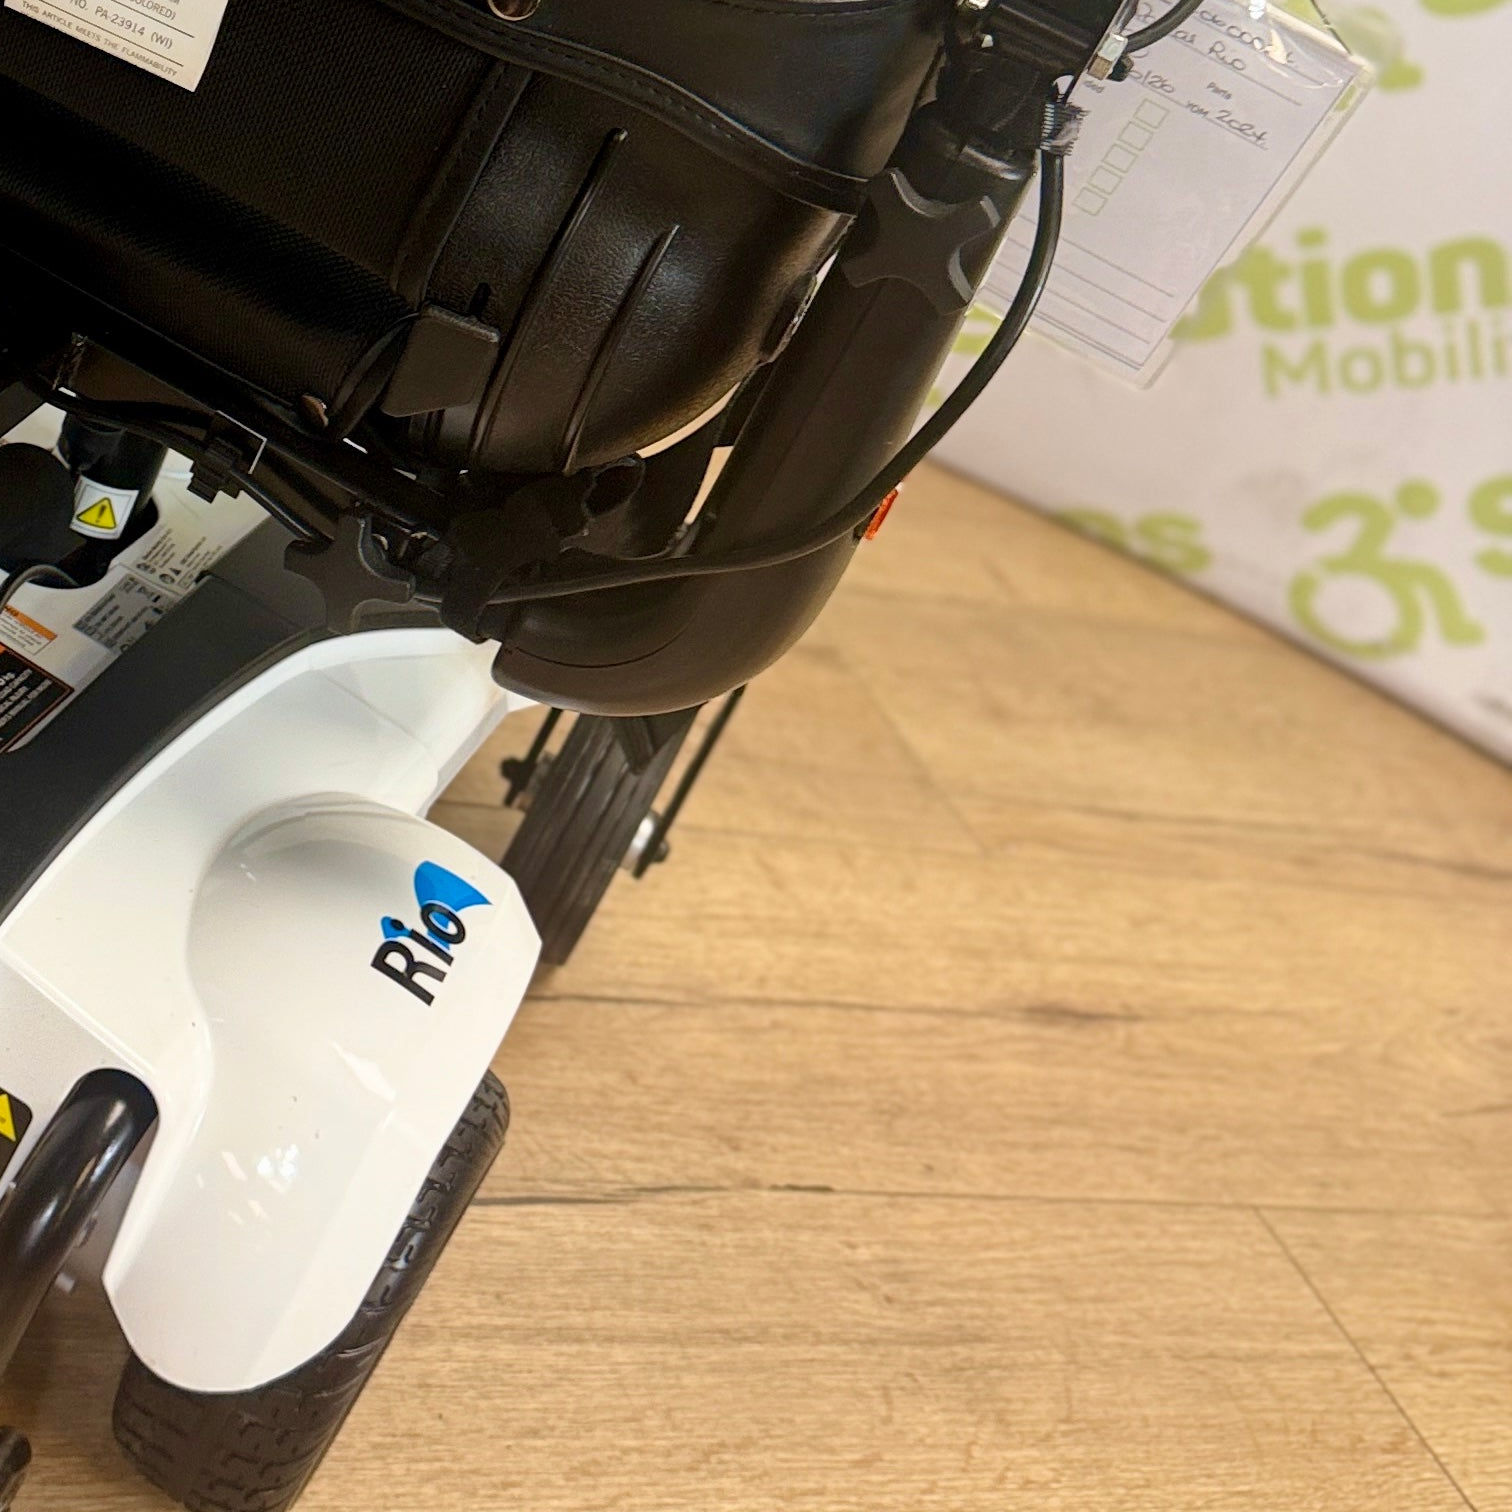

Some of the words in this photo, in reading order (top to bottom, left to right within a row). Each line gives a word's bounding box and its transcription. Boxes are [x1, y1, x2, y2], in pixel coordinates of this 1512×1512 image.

[21, 0, 39, 15] THIS
[41, 9, 73, 30] ARTICLE
[104, 38, 120, 52] THE
[121, 46, 178, 77] FLAMMABILITY
[94, 5, 146, 37] PA-23914
[150, 31, 173, 51] (WI)
[370, 902, 466, 1007] Rio
